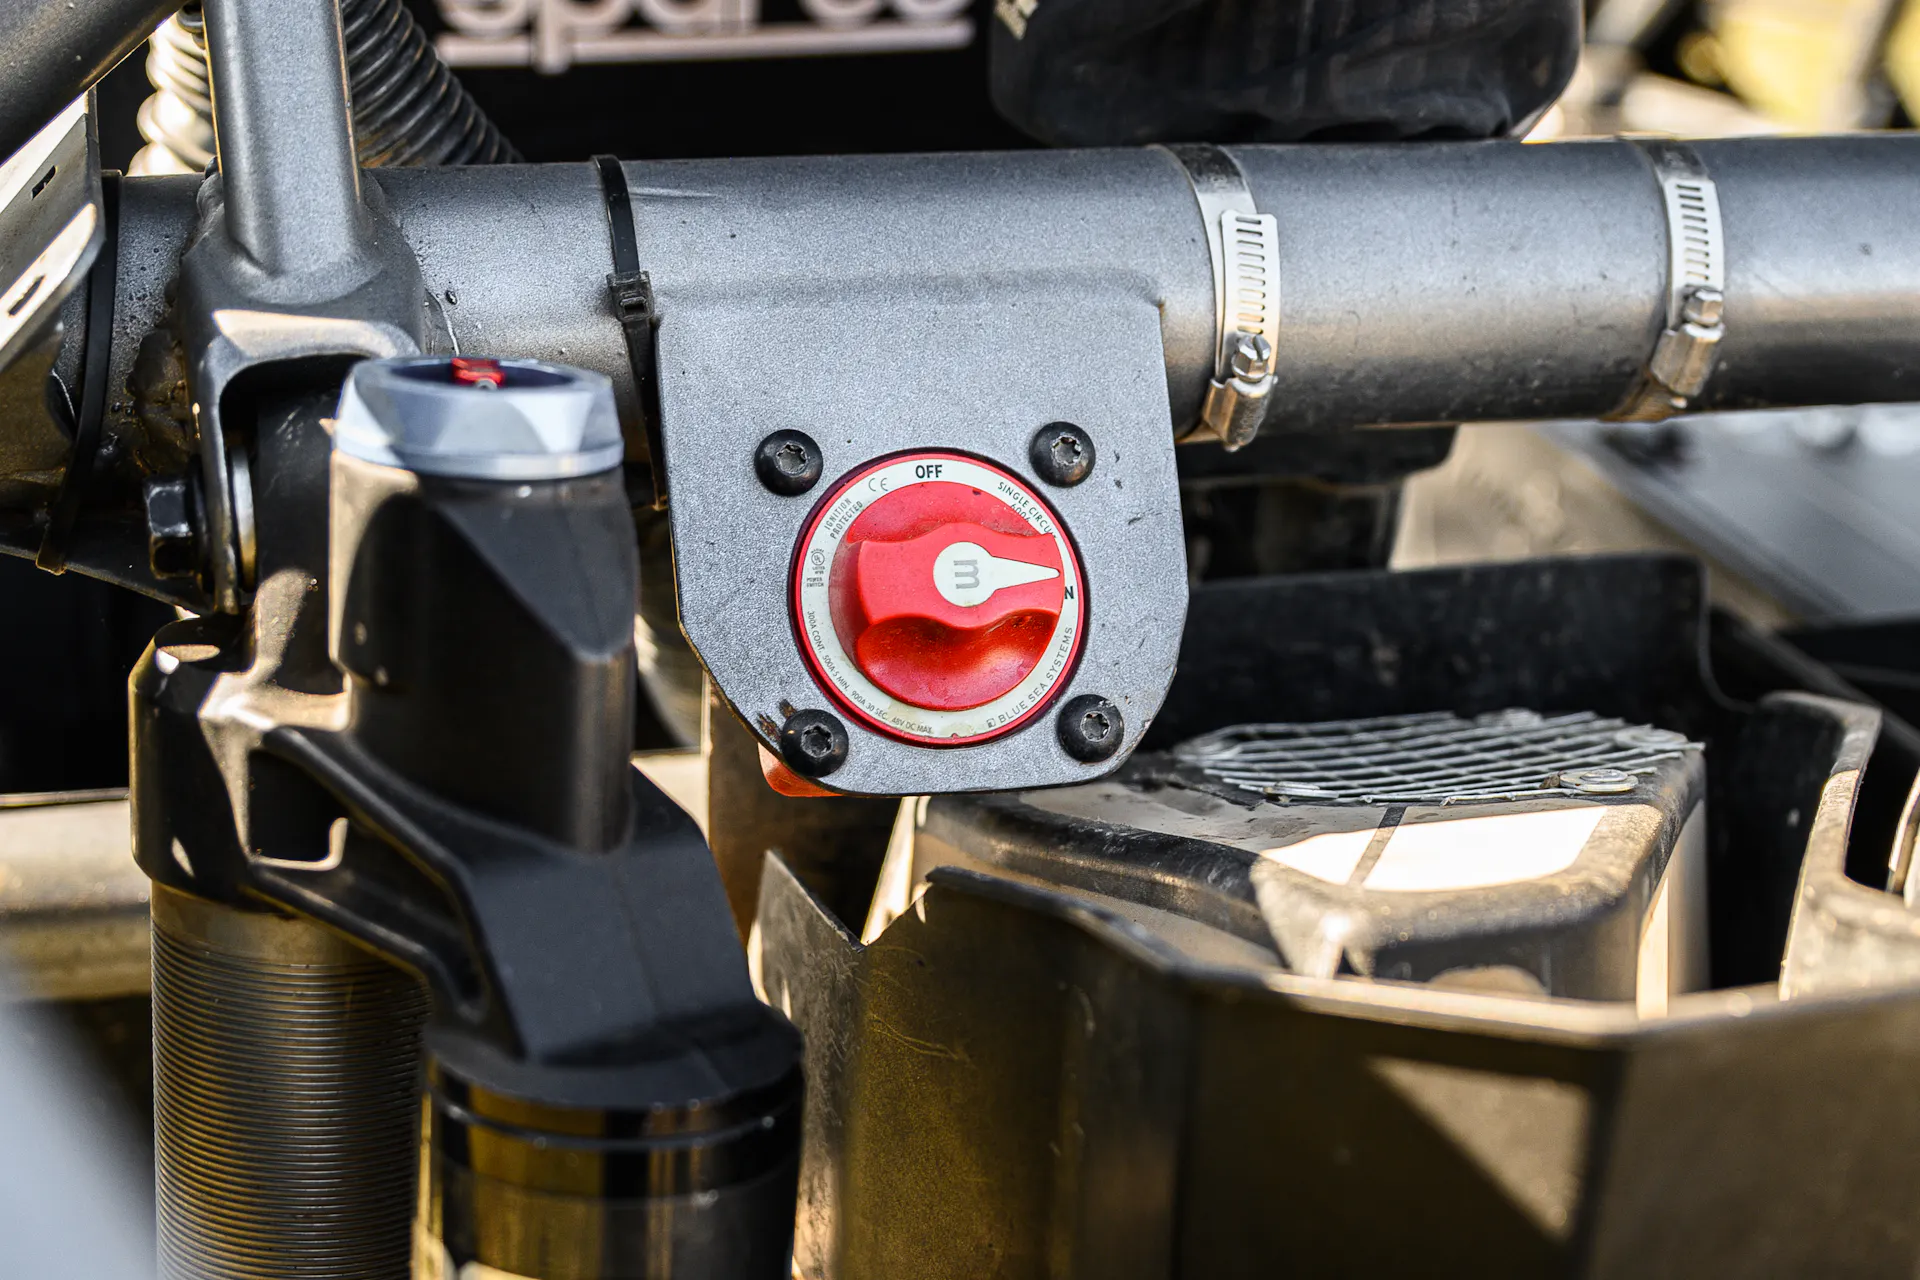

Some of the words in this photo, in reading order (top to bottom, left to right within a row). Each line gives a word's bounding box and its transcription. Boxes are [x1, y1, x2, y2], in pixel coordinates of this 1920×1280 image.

[915, 465, 943, 479] OFF
[824, 498, 852, 530] IGNITION
[830, 501, 863, 539] PROTECTED
[998, 481, 1029, 507] SINGLE
[1028, 507, 1057, 538] CIRCU
[1064, 586, 1075, 600] N
[807, 611, 817, 629] 300A
[812, 630, 825, 653] CONT.
[837, 676, 850, 692] MIN.
[851, 690, 866, 705] 900A
[865, 702, 875, 712] 30
[906, 721, 917, 731] DC
[998, 701, 1028, 723] BLUE
[1028, 682, 1048, 702] SEA
[1046, 627, 1073, 680] SYSTEMS
